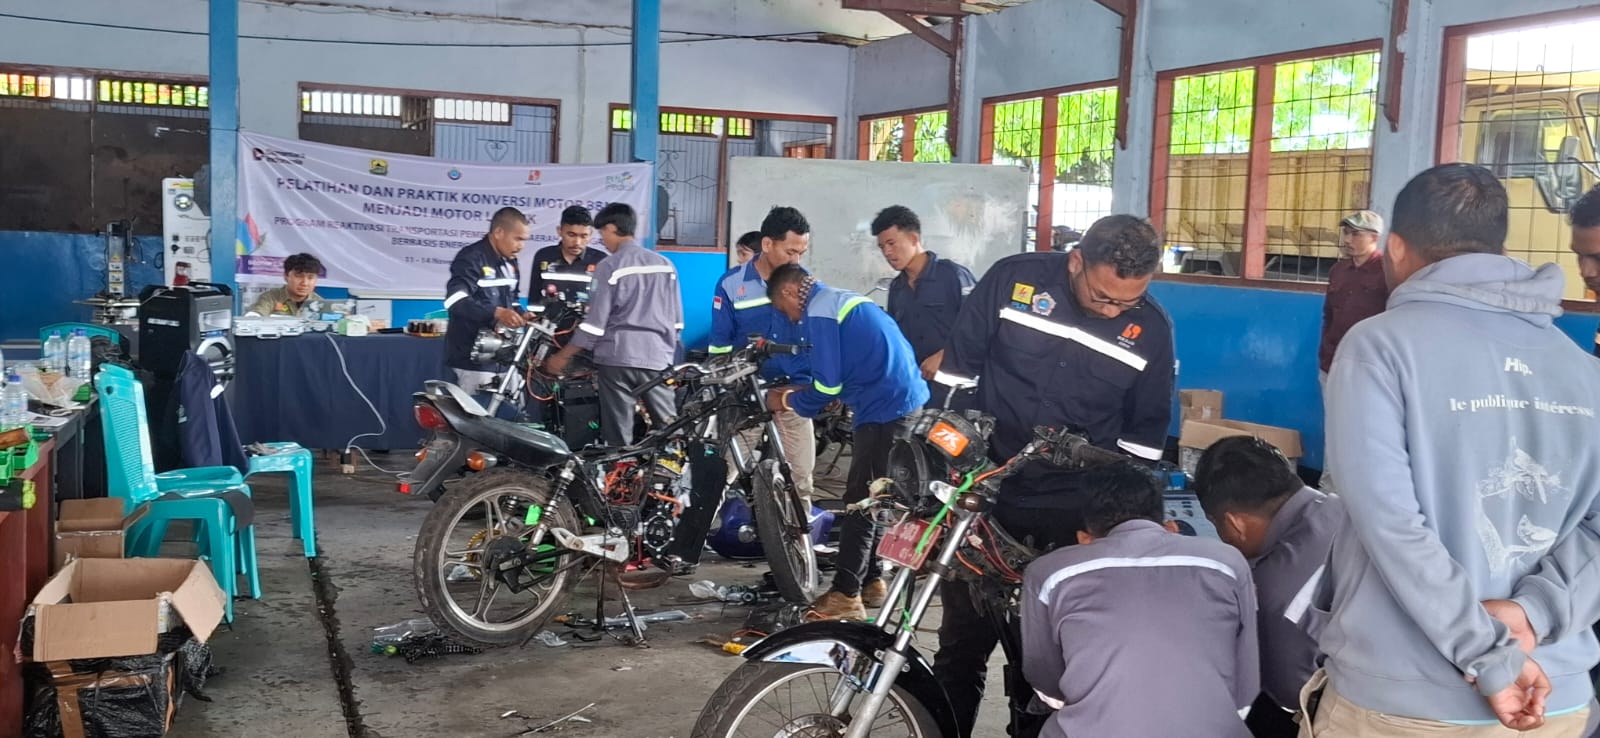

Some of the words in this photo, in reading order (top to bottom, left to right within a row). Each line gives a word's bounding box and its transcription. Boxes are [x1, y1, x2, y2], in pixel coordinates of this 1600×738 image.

[276, 177, 359, 195] PELATIHAN
[362, 184, 394, 198] DAN
[397, 188, 459, 203] PRAKTIK
[462, 193, 531, 207] KONVERSI
[535, 197, 582, 209] MOTOR
[362, 202, 428, 218] MENJADI
[431, 208, 482, 221] MOTOR
[274, 216, 326, 228] PROGRAM
[327, 220, 384, 232] REAKTIVASI
[386, 224, 458, 237] TRANSPORTASI
[529, 234, 560, 243] AERAH
[391, 237, 437, 248] BERBASIS
[1504, 356, 1533, 376] Hip.
[1449, 398, 1467, 412] le
[1470, 394, 1530, 412] publique
